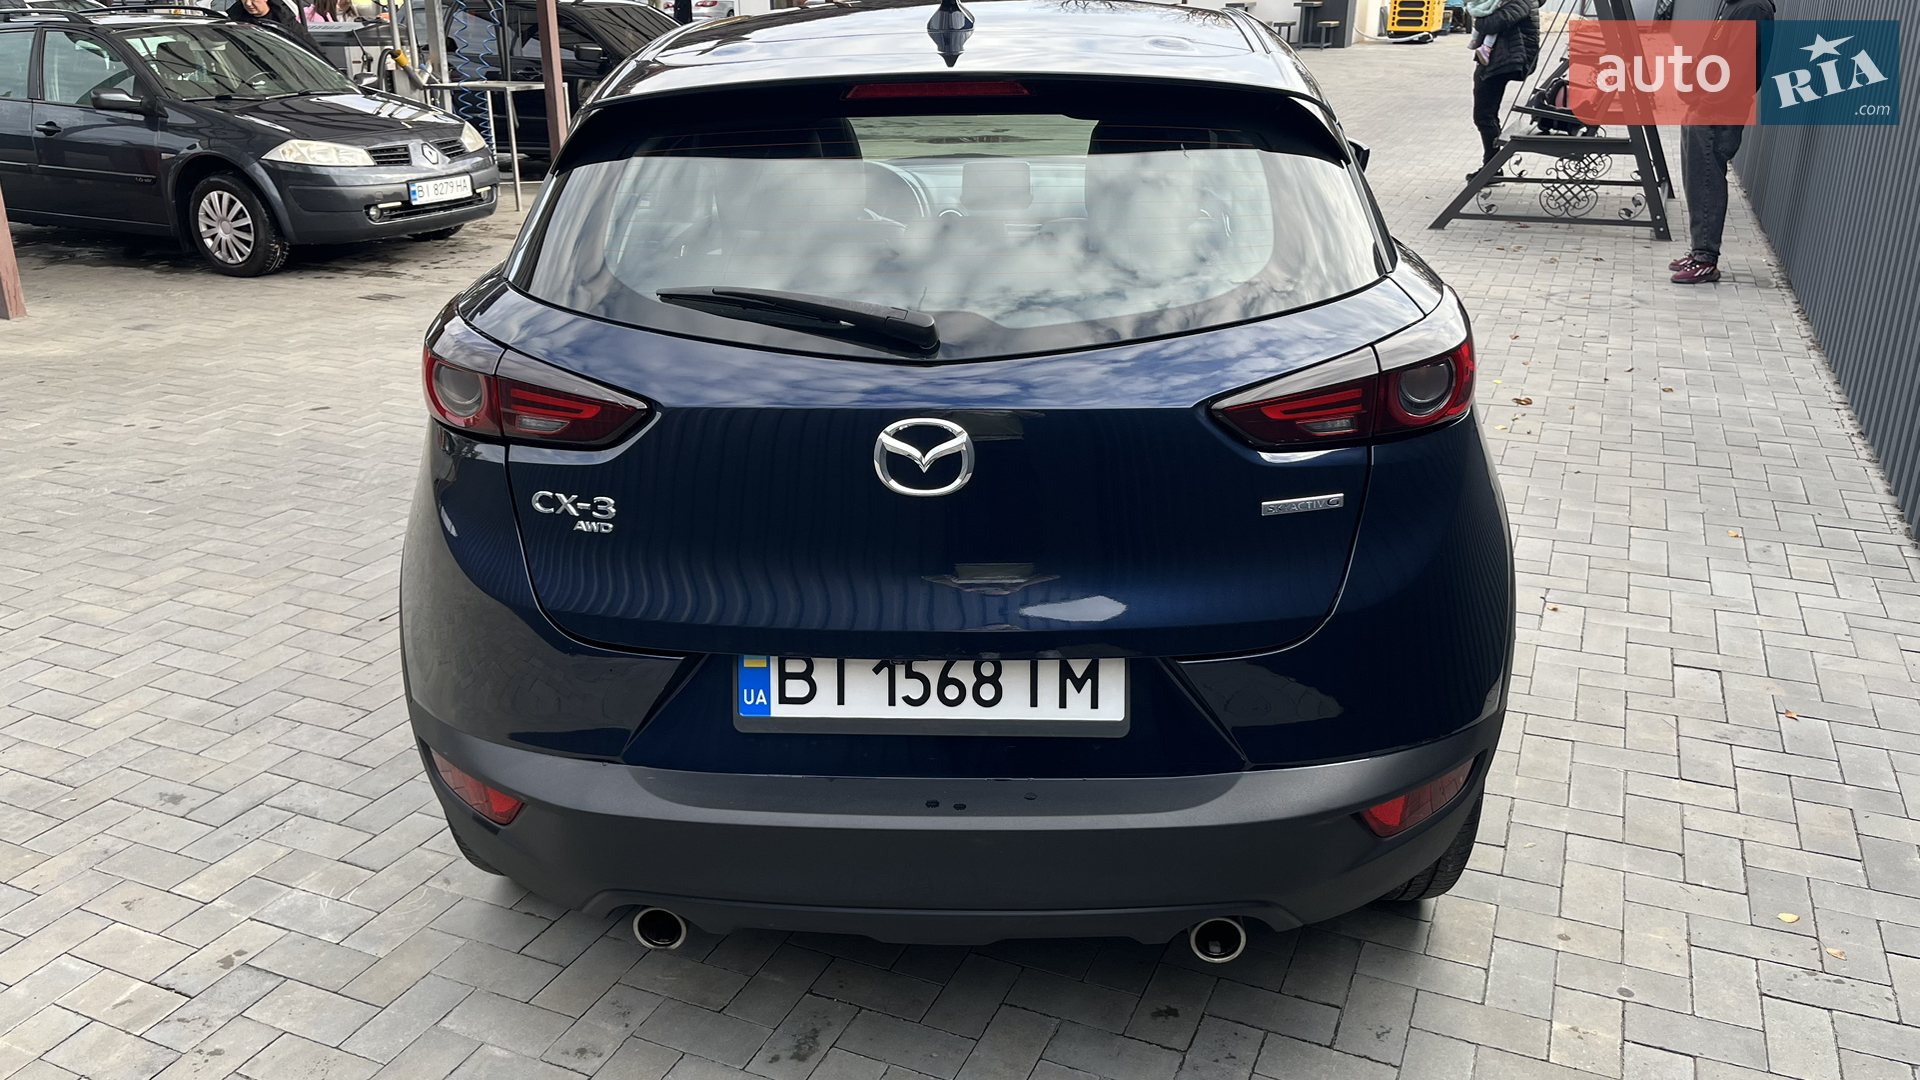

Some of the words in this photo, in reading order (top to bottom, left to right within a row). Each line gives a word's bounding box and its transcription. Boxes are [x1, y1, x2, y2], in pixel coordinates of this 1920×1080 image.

[417, 184, 430, 198] BI
[433, 181, 455, 196] 8279
[455, 179, 469, 192] HA
[531, 490, 617, 519] CX-3
[573, 520, 614, 533] AWD
[777, 656, 845, 706] BI
[872, 659, 1003, 708] 1568
[1030, 658, 1099, 709] IM
[743, 689, 768, 705] UA
